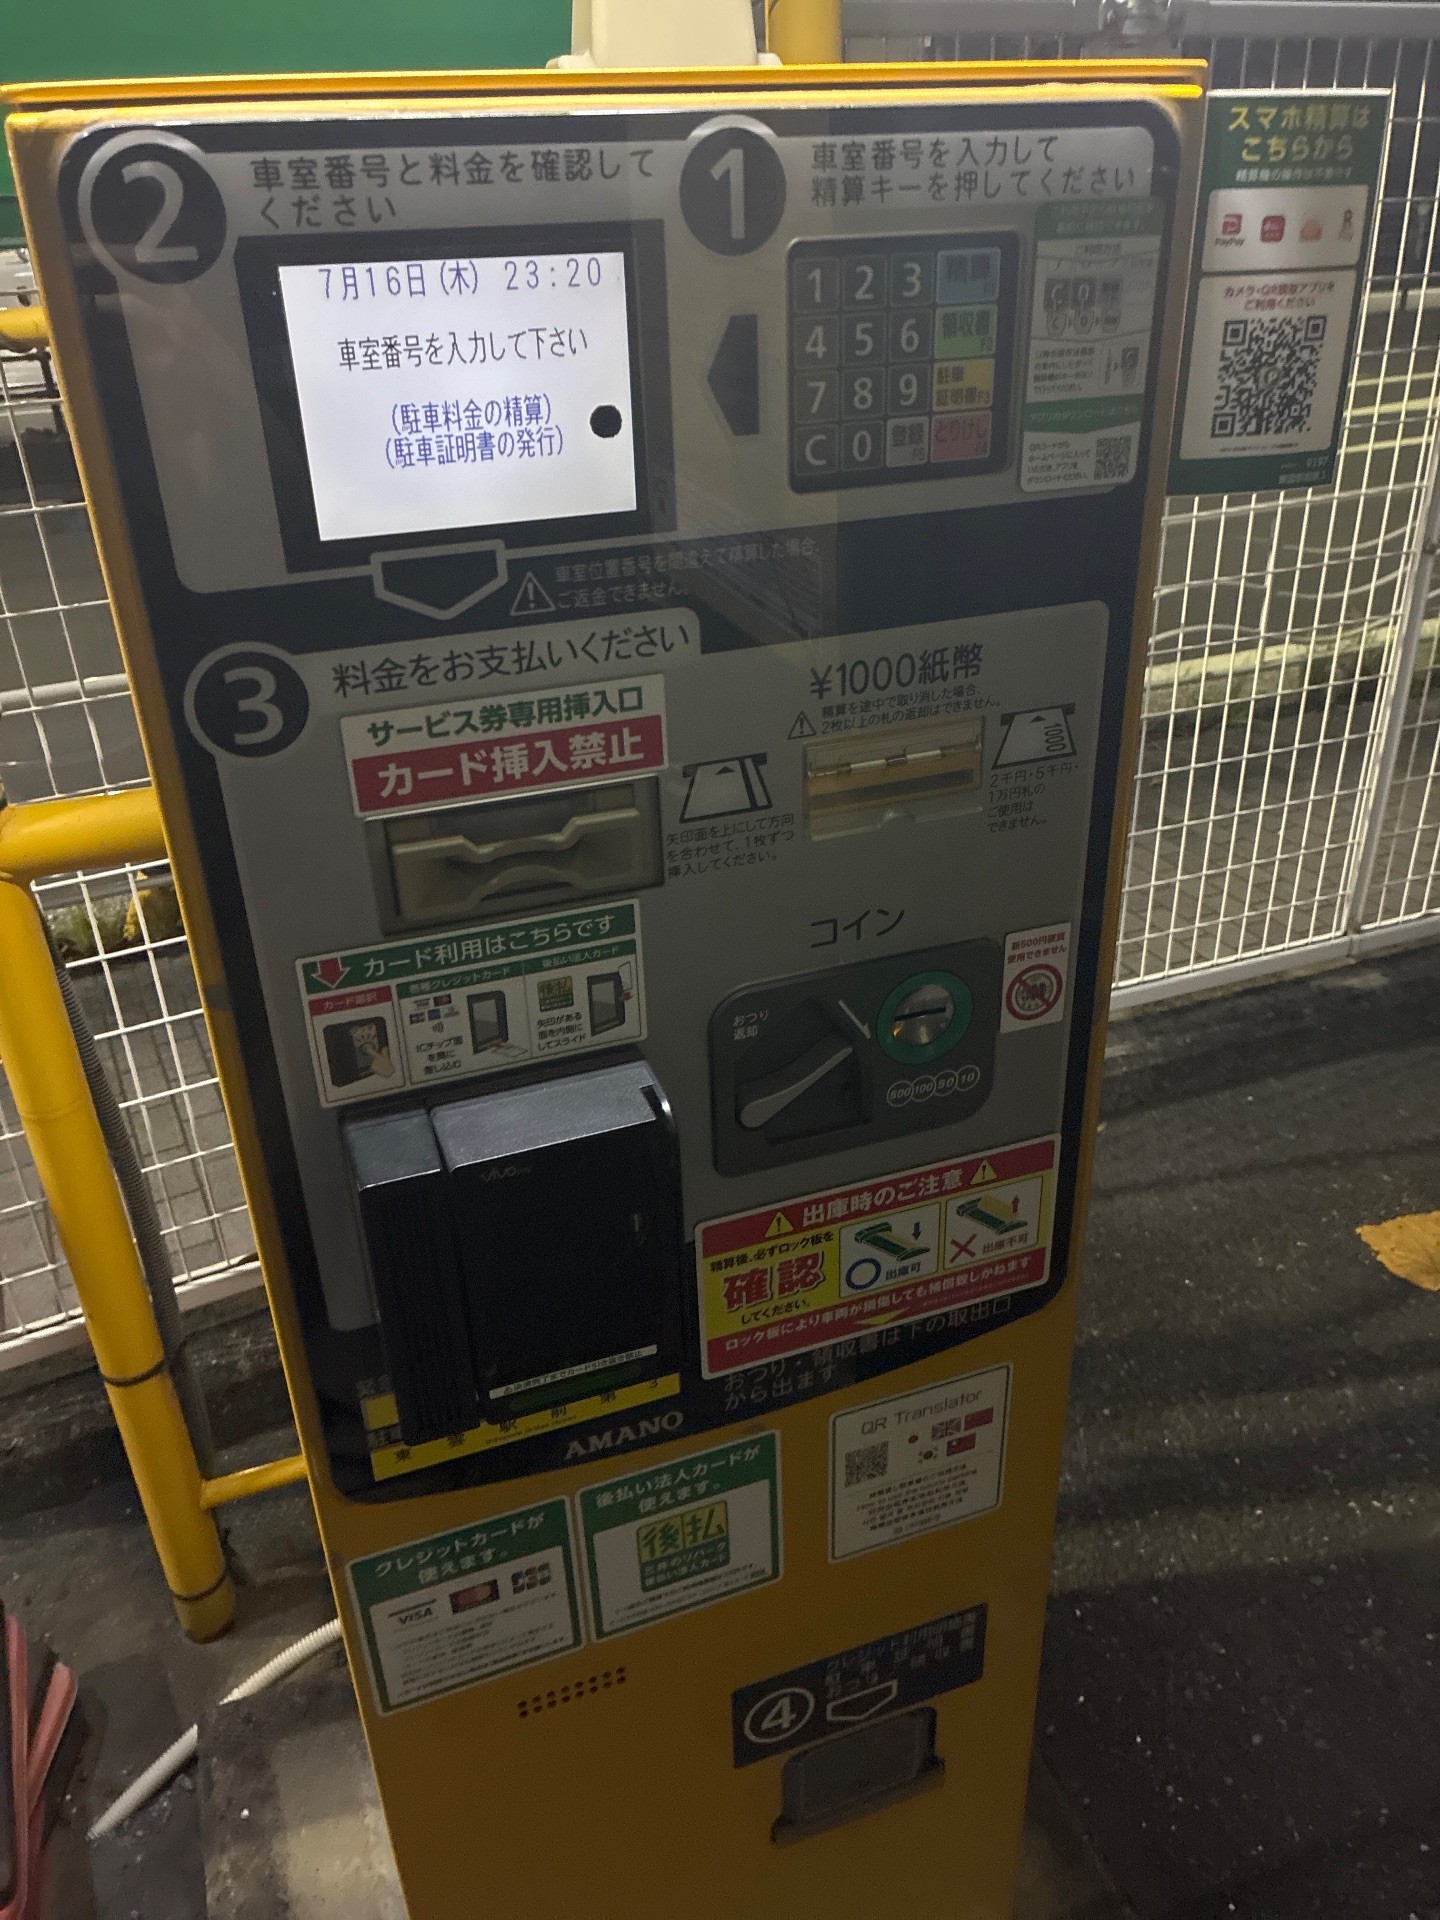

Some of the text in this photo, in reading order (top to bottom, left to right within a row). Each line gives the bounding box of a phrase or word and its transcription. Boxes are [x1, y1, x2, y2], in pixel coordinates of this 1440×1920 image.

[1227, 103, 1371, 132] スマホ精算は
[811, 136, 1059, 171] 車室番号を入力して
[1241, 133, 1354, 163] こちらから
[250, 147, 655, 192] 車室番号と料金を確認して
[811, 167, 1134, 207] 精算キーを押してください
[121, 160, 198, 263] 2
[257, 195, 396, 230] ください
[709, 148, 745, 240] 1
[504, 256, 602, 291] 23:20
[807, 262, 921, 303] 1 2 3
[337, 327, 588, 373] 車室番号を入力して下さい
[805, 318, 920, 359] 4 5 6
[391, 392, 553, 436] (駐車料金の精算)
[807, 373, 918, 415] 7 8 9
[385, 425, 564, 469] (駐車証明書の発行)
[805, 430, 872, 466] C 0
[556, 580, 689, 609] ご返金できません。
[331, 622, 690, 698] 料金をお支払いください
[809, 642, 983, 700] ¥1000紙幣
[222, 666, 284, 745] 3
[366, 686, 644, 747] サービス券専用挿入口
[377, 726, 645, 800] カード挿入禁止
[987, 800, 1034, 818] ご使用は
[988, 785, 1046, 803] 1万円札の
[666, 814, 794, 847] 矢印面を上にして方向
[986, 815, 1048, 833] できません。
[666, 830, 794, 863] を合わせて、1枚ずつ
[667, 853, 778, 879] 挿入してください。
[363, 914, 615, 979] カード利用はこちらです
[810, 907, 905, 949] コイン
[1007, 945, 1067, 964] 使用できません
[537, 1012, 583, 1029] 矢印がある
[733, 1009, 769, 1026] おつり
[733, 1025, 759, 1041] 返却
[538, 1034, 587, 1052] してスライド
[913, 1081, 934, 1095] 100
[938, 1076, 954, 1089] 50
[960, 1070, 975, 1084] 10
[803, 1169, 963, 1229] 出庫時のご注意
[710, 1230, 835, 1274] 精算後、必ずロック板を
[982, 1232, 1029, 1254] 出庫不可
[722, 1252, 826, 1313] 確認
[885, 1260, 922, 1282] 出庫可
[725, 1256, 1033, 1352] ロック板により車両が損傷しても補償致しかねます
[725, 1363, 838, 1411] から出ます
[860, 1389, 983, 1435] QR Translator
[563, 1411, 684, 1460] AMANO
[596, 1444, 761, 1508] 後払い法人カードが
[638, 1478, 721, 1513] 使えます。
[374, 1512, 545, 1578] クレジットカードが
[642, 1508, 725, 1559] 後払
[417, 1549, 508, 1585] 使えます。
[397, 1607, 434, 1625] VISA
[761, 1697, 798, 1731] 4
